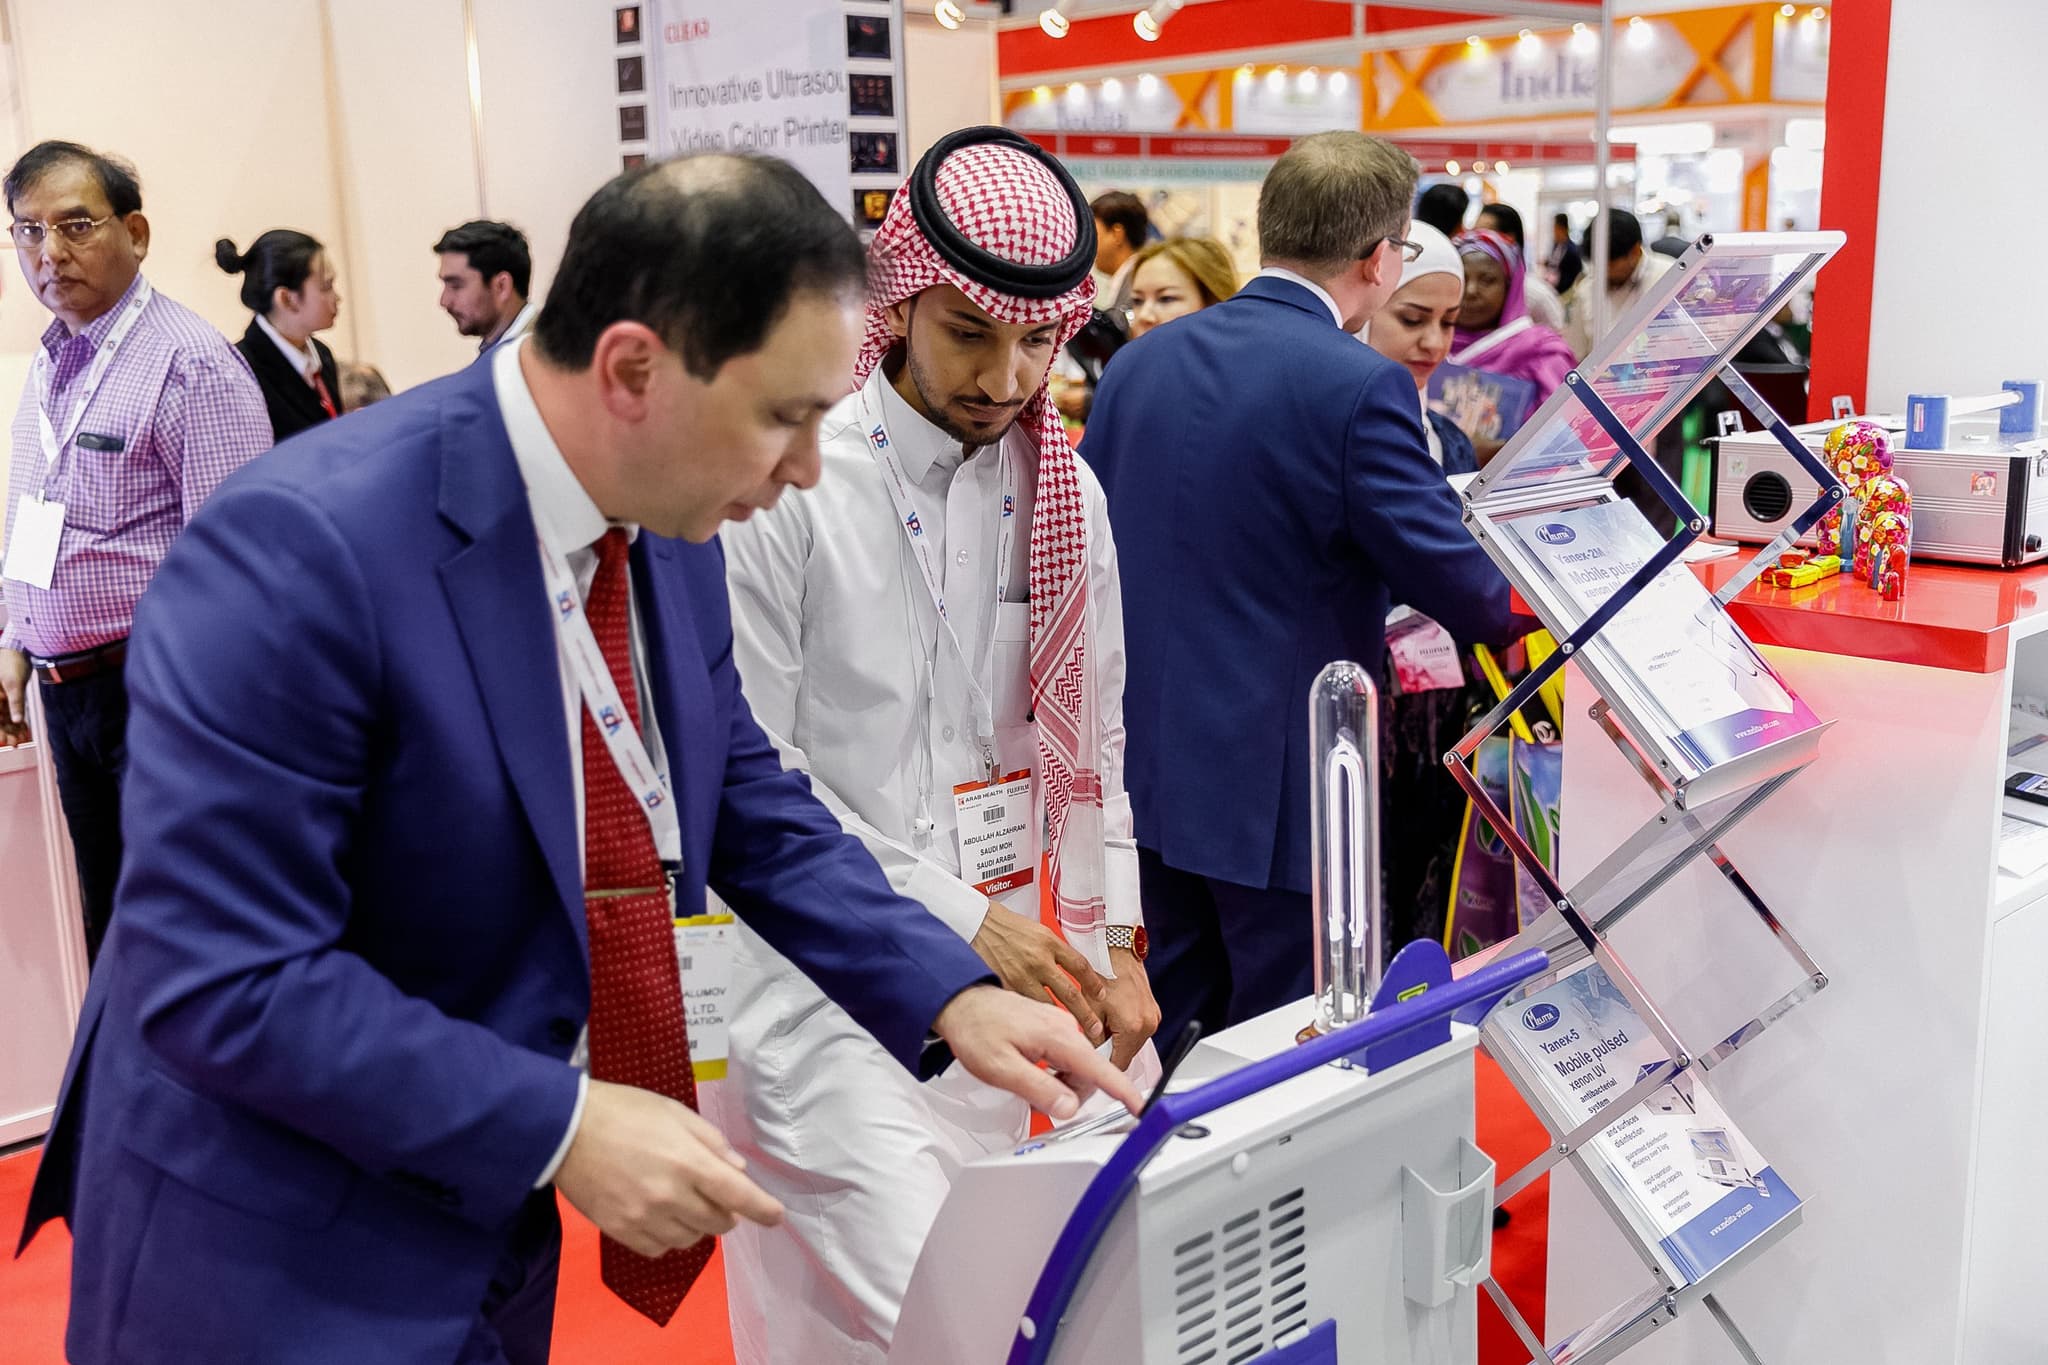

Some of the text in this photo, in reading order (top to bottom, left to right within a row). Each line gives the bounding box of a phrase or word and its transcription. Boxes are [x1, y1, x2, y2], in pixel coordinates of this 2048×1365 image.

[729, 121, 780, 150] Color
[1568, 567, 1610, 585] Mobile
[965, 794, 982, 803] ARAB
[982, 789, 1004, 799] HEALTH
[1006, 783, 1030, 795] FUJIFILM
[963, 823, 1027, 846] ABDULLAH ALZAHRANI
[980, 840, 1013, 856] SAUDI MOH
[976, 852, 1017, 871] SAUDI ARABIA
[1539, 1028, 1580, 1054] Yanex-5
[1553, 1029, 1629, 1078] Mobile pulsed
[1569, 1062, 1607, 1091] xenon UV
[1579, 1077, 1618, 1103] antibacterial
[1587, 1097, 1611, 1114] system
[1606, 1115, 1640, 1138] and surfaces
